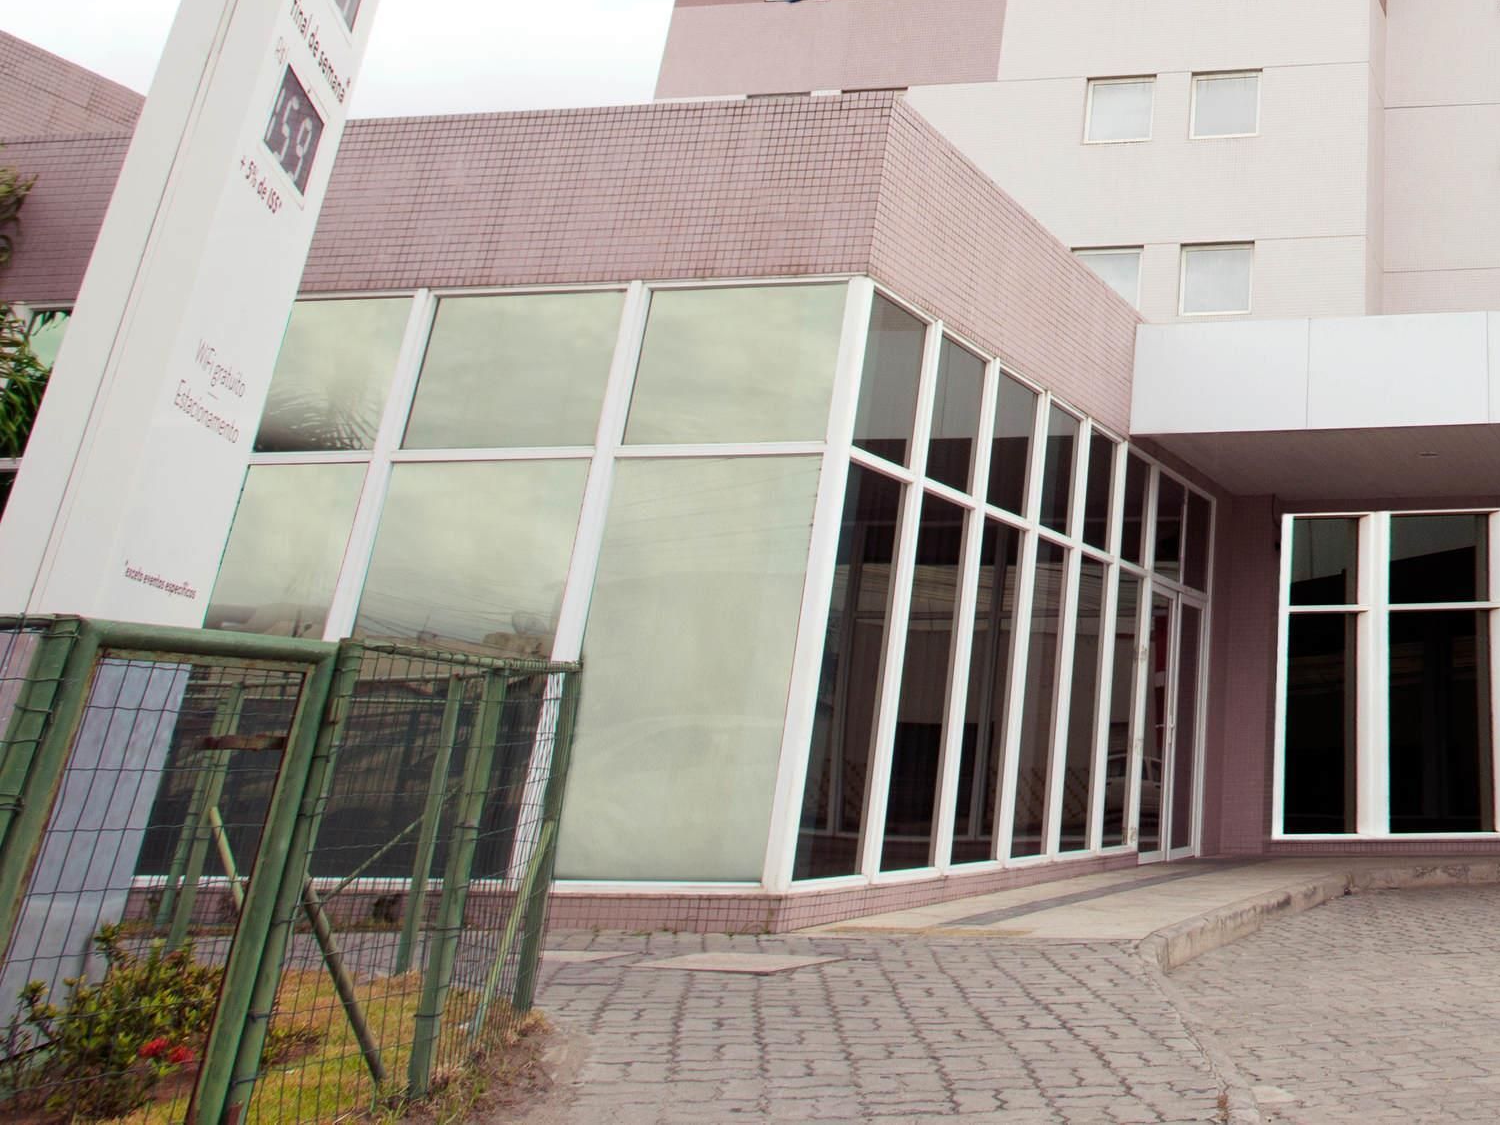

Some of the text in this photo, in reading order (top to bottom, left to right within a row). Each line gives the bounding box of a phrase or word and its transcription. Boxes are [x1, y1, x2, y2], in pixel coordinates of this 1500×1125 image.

[307, 23, 321, 58] de
[257, 175, 268, 200] de
[210, 363, 246, 398] gratuito
[174, 378, 240, 444] Estacionamento
[143, 573, 166, 590] eventos
